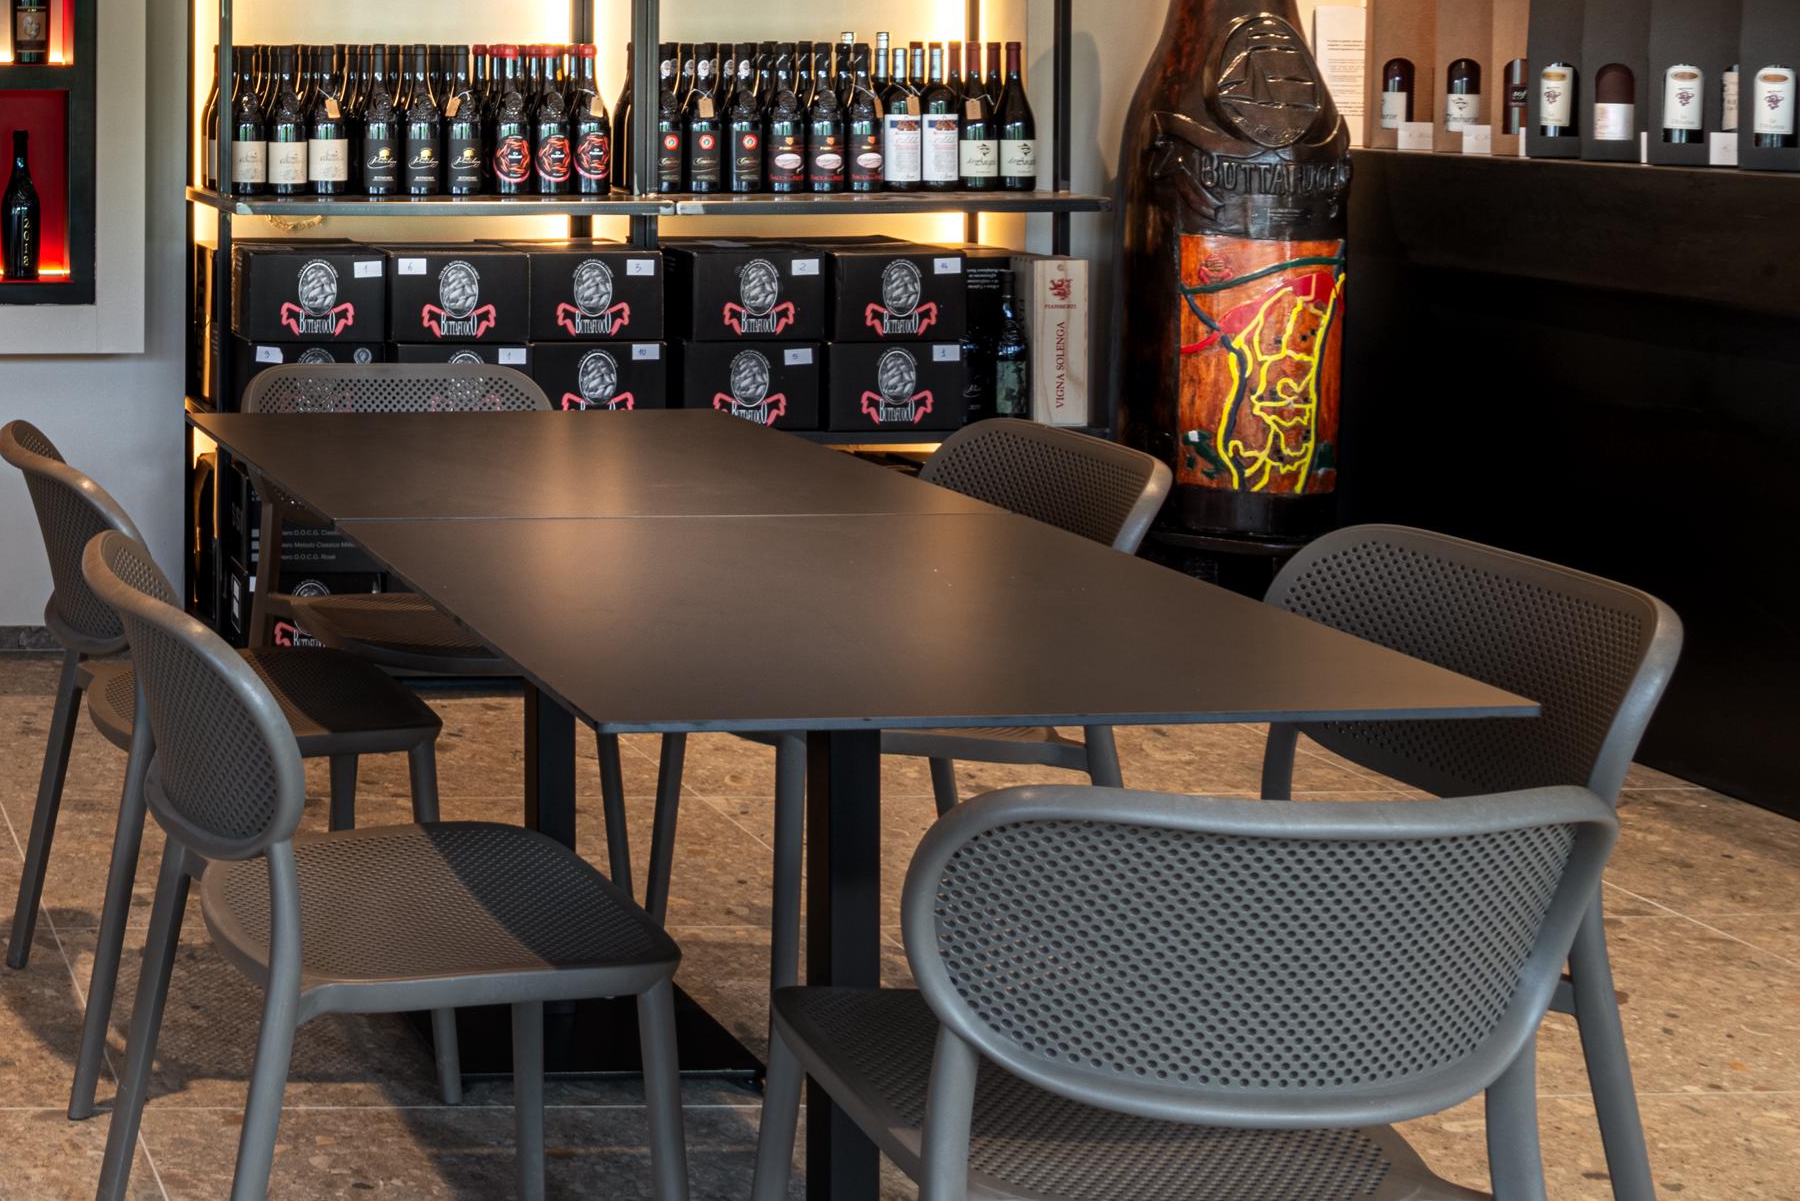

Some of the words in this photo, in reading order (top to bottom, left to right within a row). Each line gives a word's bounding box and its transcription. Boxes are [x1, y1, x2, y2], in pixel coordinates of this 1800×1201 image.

[299, 312, 336, 336] BUTTAFUOCO
[440, 313, 477, 337] BUTTAFUOCO
[575, 312, 612, 336] BUTTAFUOCO
[741, 311, 777, 334] BUTTAFUOCO
[883, 311, 918, 334] BUTTAFUOCO
[1055, 321, 1065, 371] SOLENGA
[1055, 373, 1065, 409] VIGNA
[879, 400, 915, 424] BUTTAFUOCO
